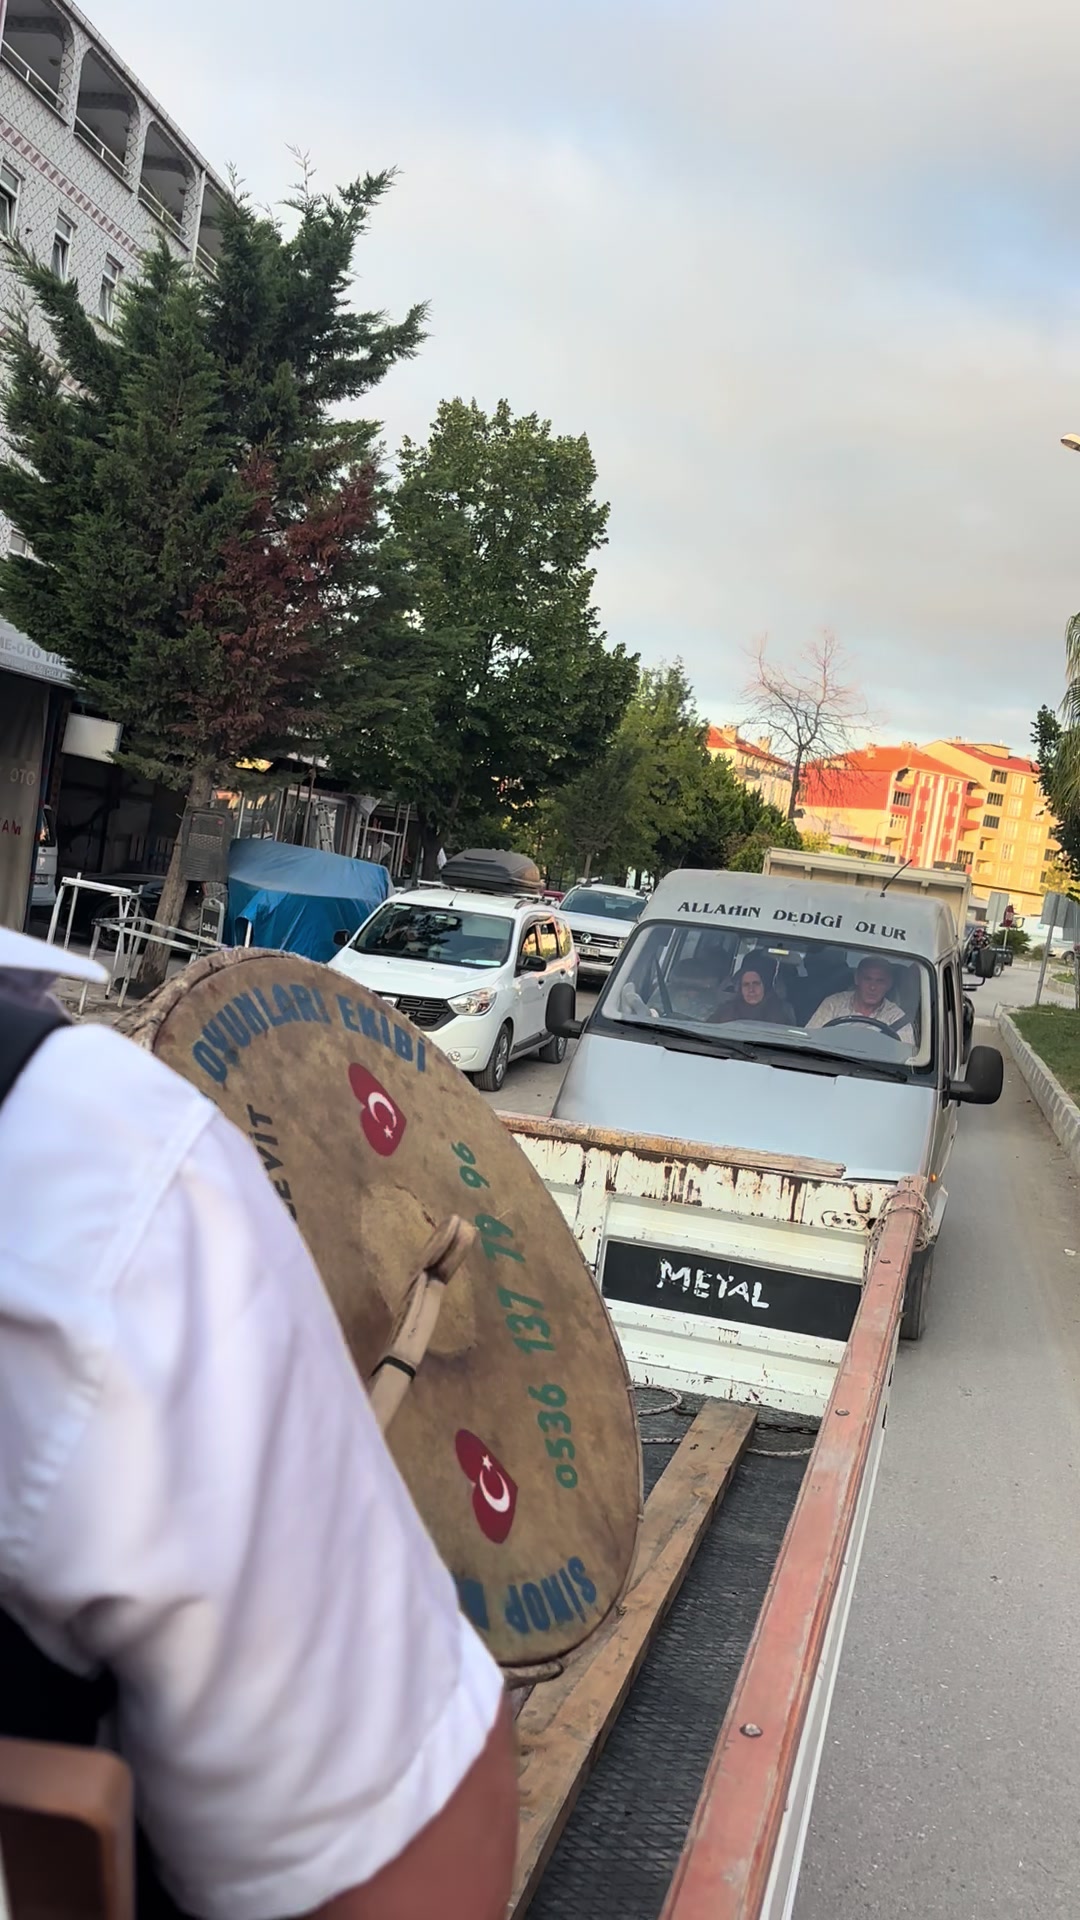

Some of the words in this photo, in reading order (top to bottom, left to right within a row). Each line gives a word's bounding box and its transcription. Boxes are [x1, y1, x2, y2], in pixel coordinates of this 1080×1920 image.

[10, 768, 36, 786] OTO
[0, 817, 21, 835] AM
[855, 921, 907, 941] OLUR
[451, 1141, 491, 1189] 96
[474, 1213, 527, 1264] 79
[656, 1258, 770, 1309] METAL
[498, 1285, 556, 1356] 137
[528, 1383, 579, 1489] 0536
